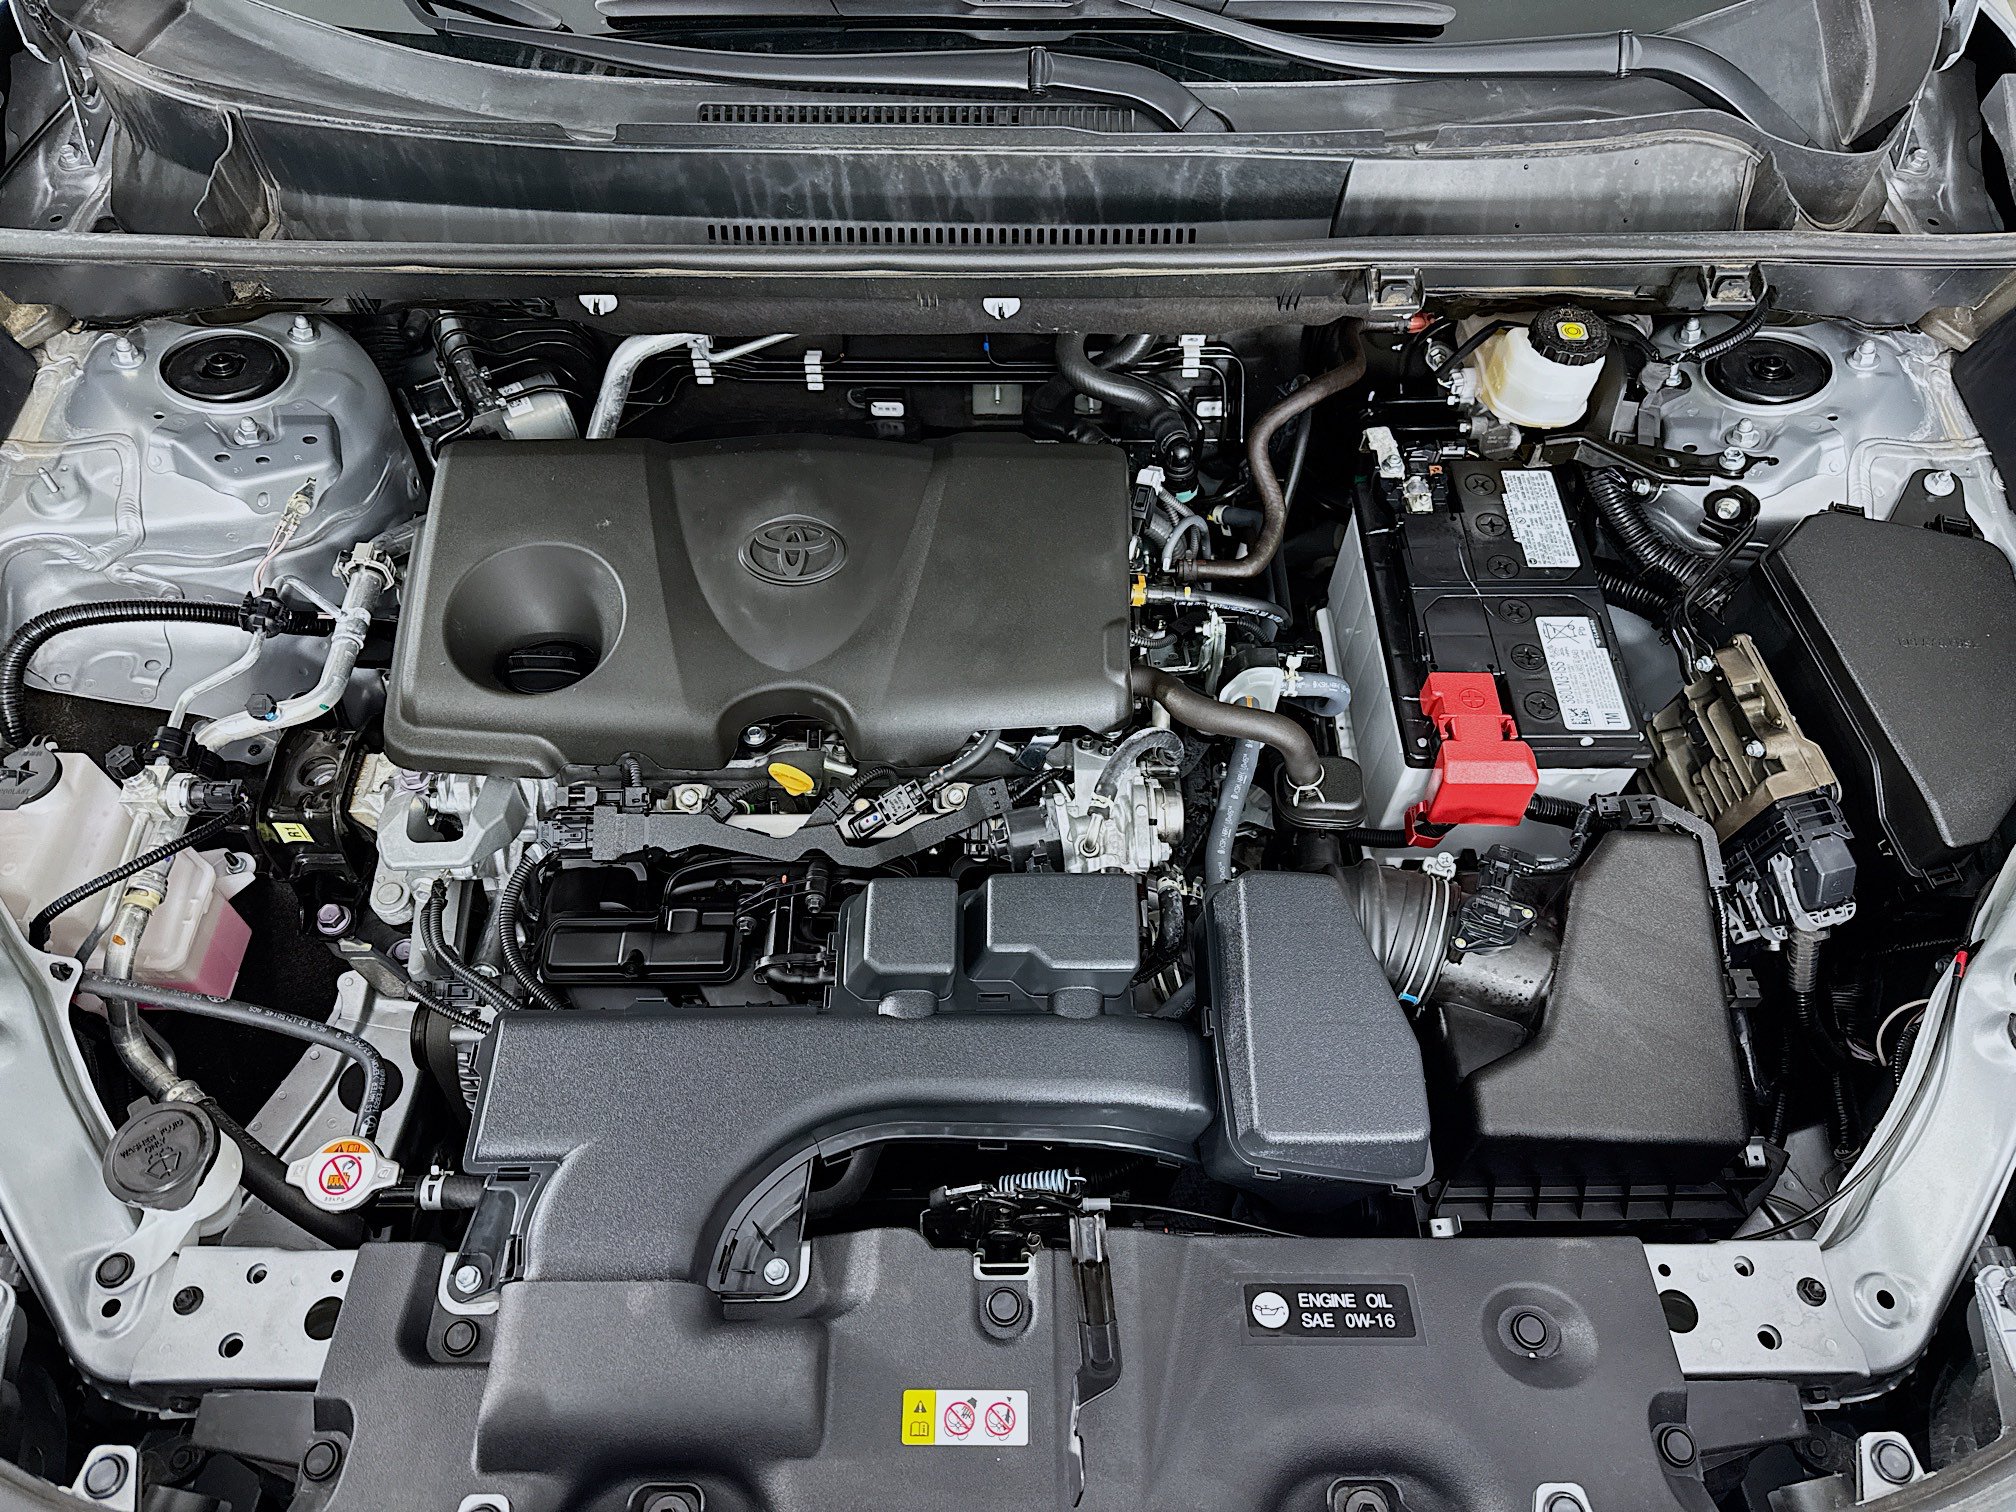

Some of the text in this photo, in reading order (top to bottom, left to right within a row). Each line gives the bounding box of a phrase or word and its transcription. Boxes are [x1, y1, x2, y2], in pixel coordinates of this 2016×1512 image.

[1603, 712, 1622, 725] TM
[1298, 1293, 1393, 1309] ENGINE OIL
[1301, 1313, 1396, 1328] SAE 0W-16
